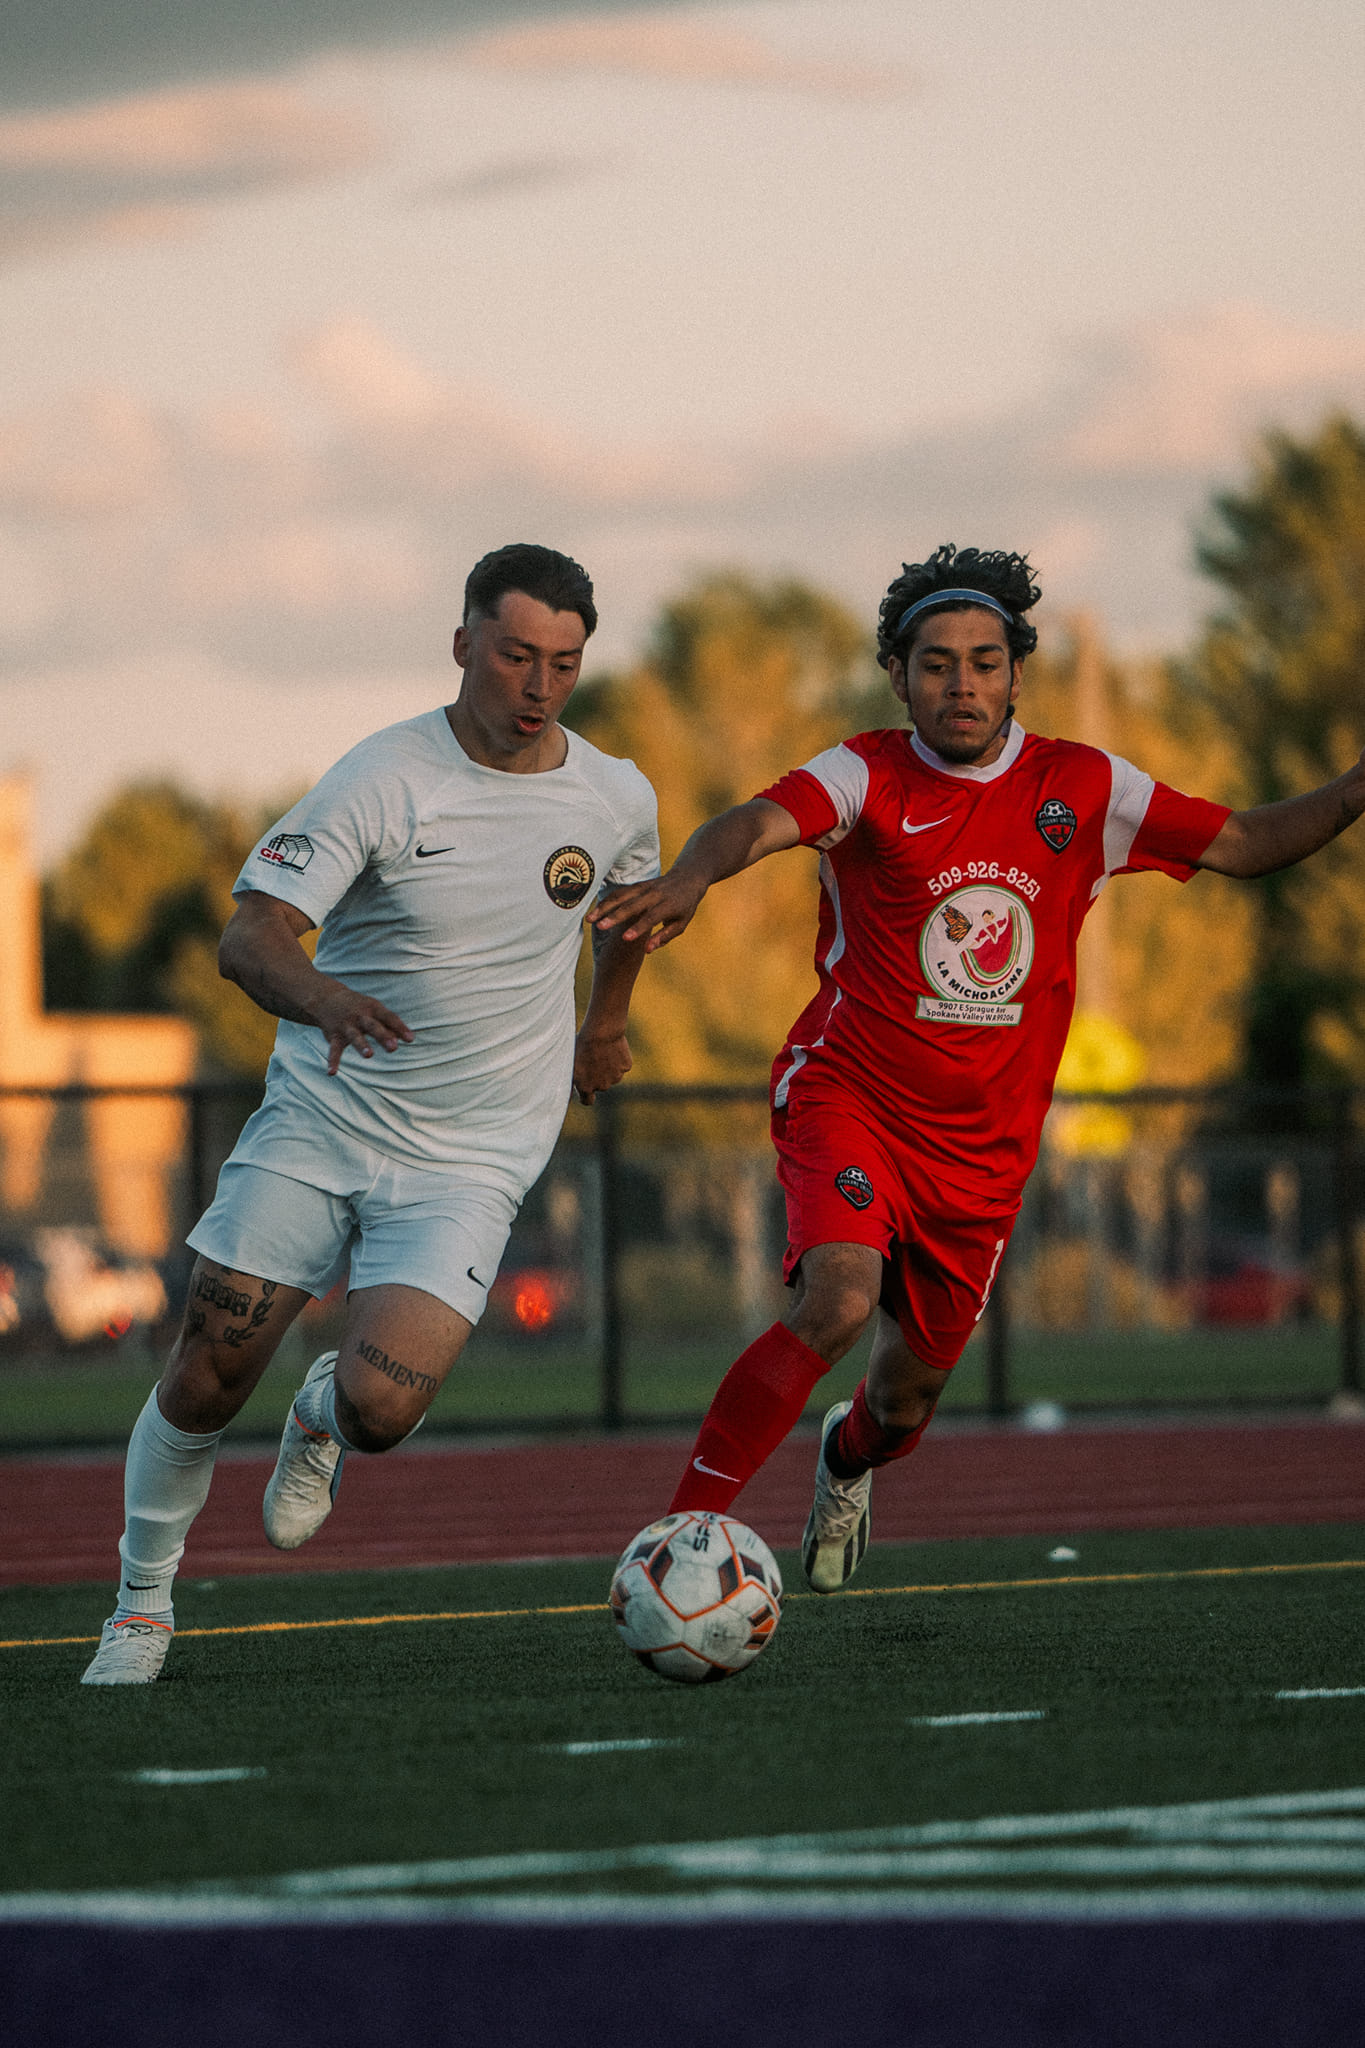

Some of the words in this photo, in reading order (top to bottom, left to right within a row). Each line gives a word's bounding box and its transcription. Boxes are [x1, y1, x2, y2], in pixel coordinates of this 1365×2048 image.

[260, 848, 284, 863] GR
[927, 861, 1042, 902] 509-926-8251
[937, 961, 950, 978] LA
[948, 967, 1024, 1000] MICHOACANA
[926, 1009, 961, 1020] Spokane
[962, 1010, 985, 1022] Valley
[938, 1002, 959, 1011] 9907
[965, 1004, 995, 1014] Sprague
[356, 1340, 438, 1392] MEMENTO
